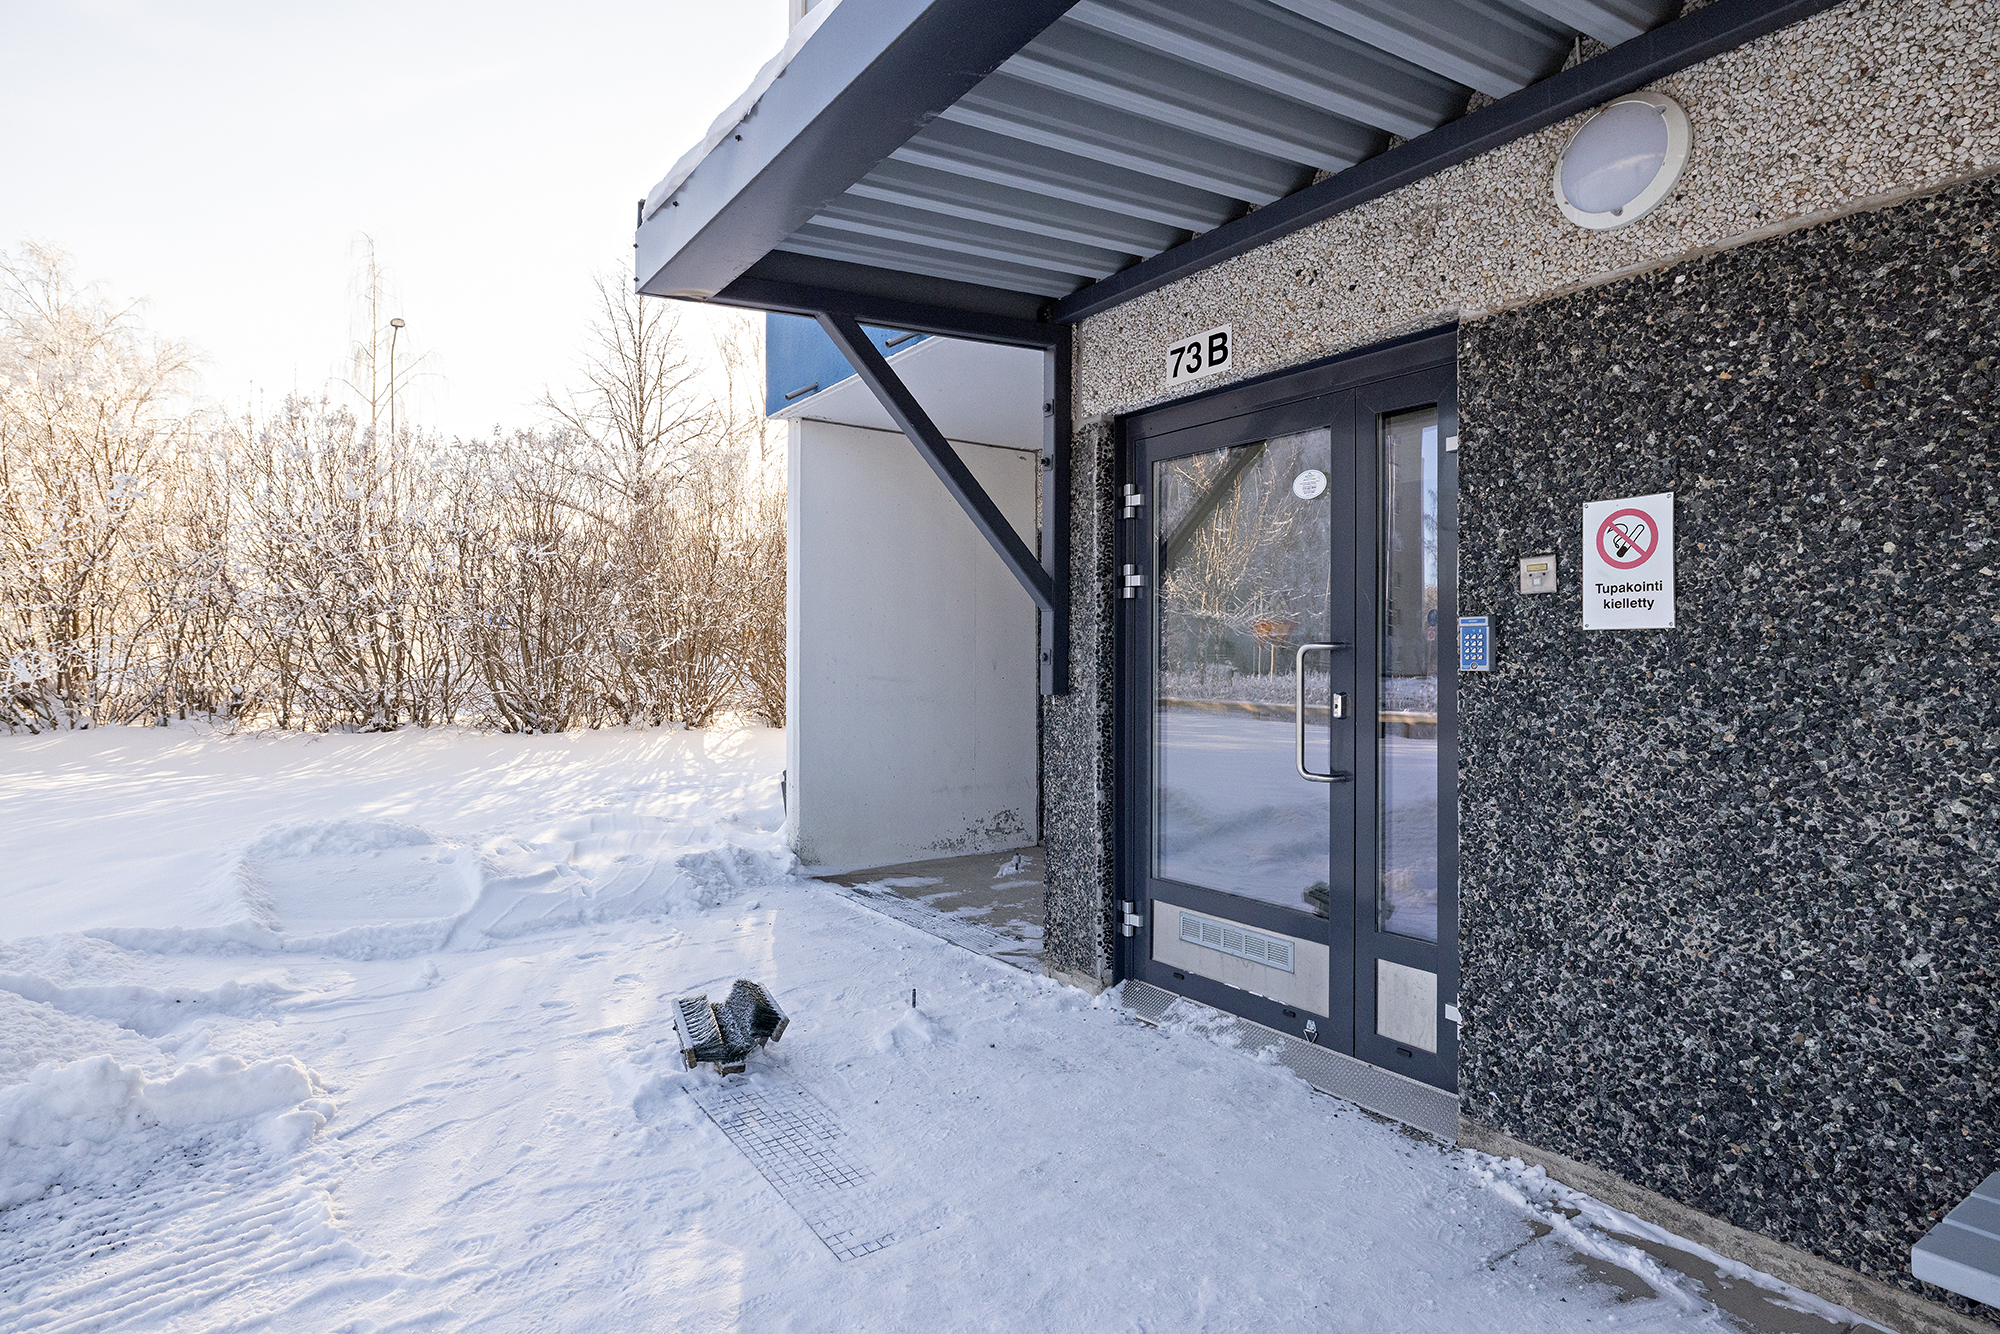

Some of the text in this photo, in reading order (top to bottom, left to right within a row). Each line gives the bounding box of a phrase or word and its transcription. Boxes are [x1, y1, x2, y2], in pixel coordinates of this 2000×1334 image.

[1170, 332, 1229, 378] 73 B
[1595, 579, 1663, 596] Tupakointi
[1603, 597, 1655, 611] kielletty
